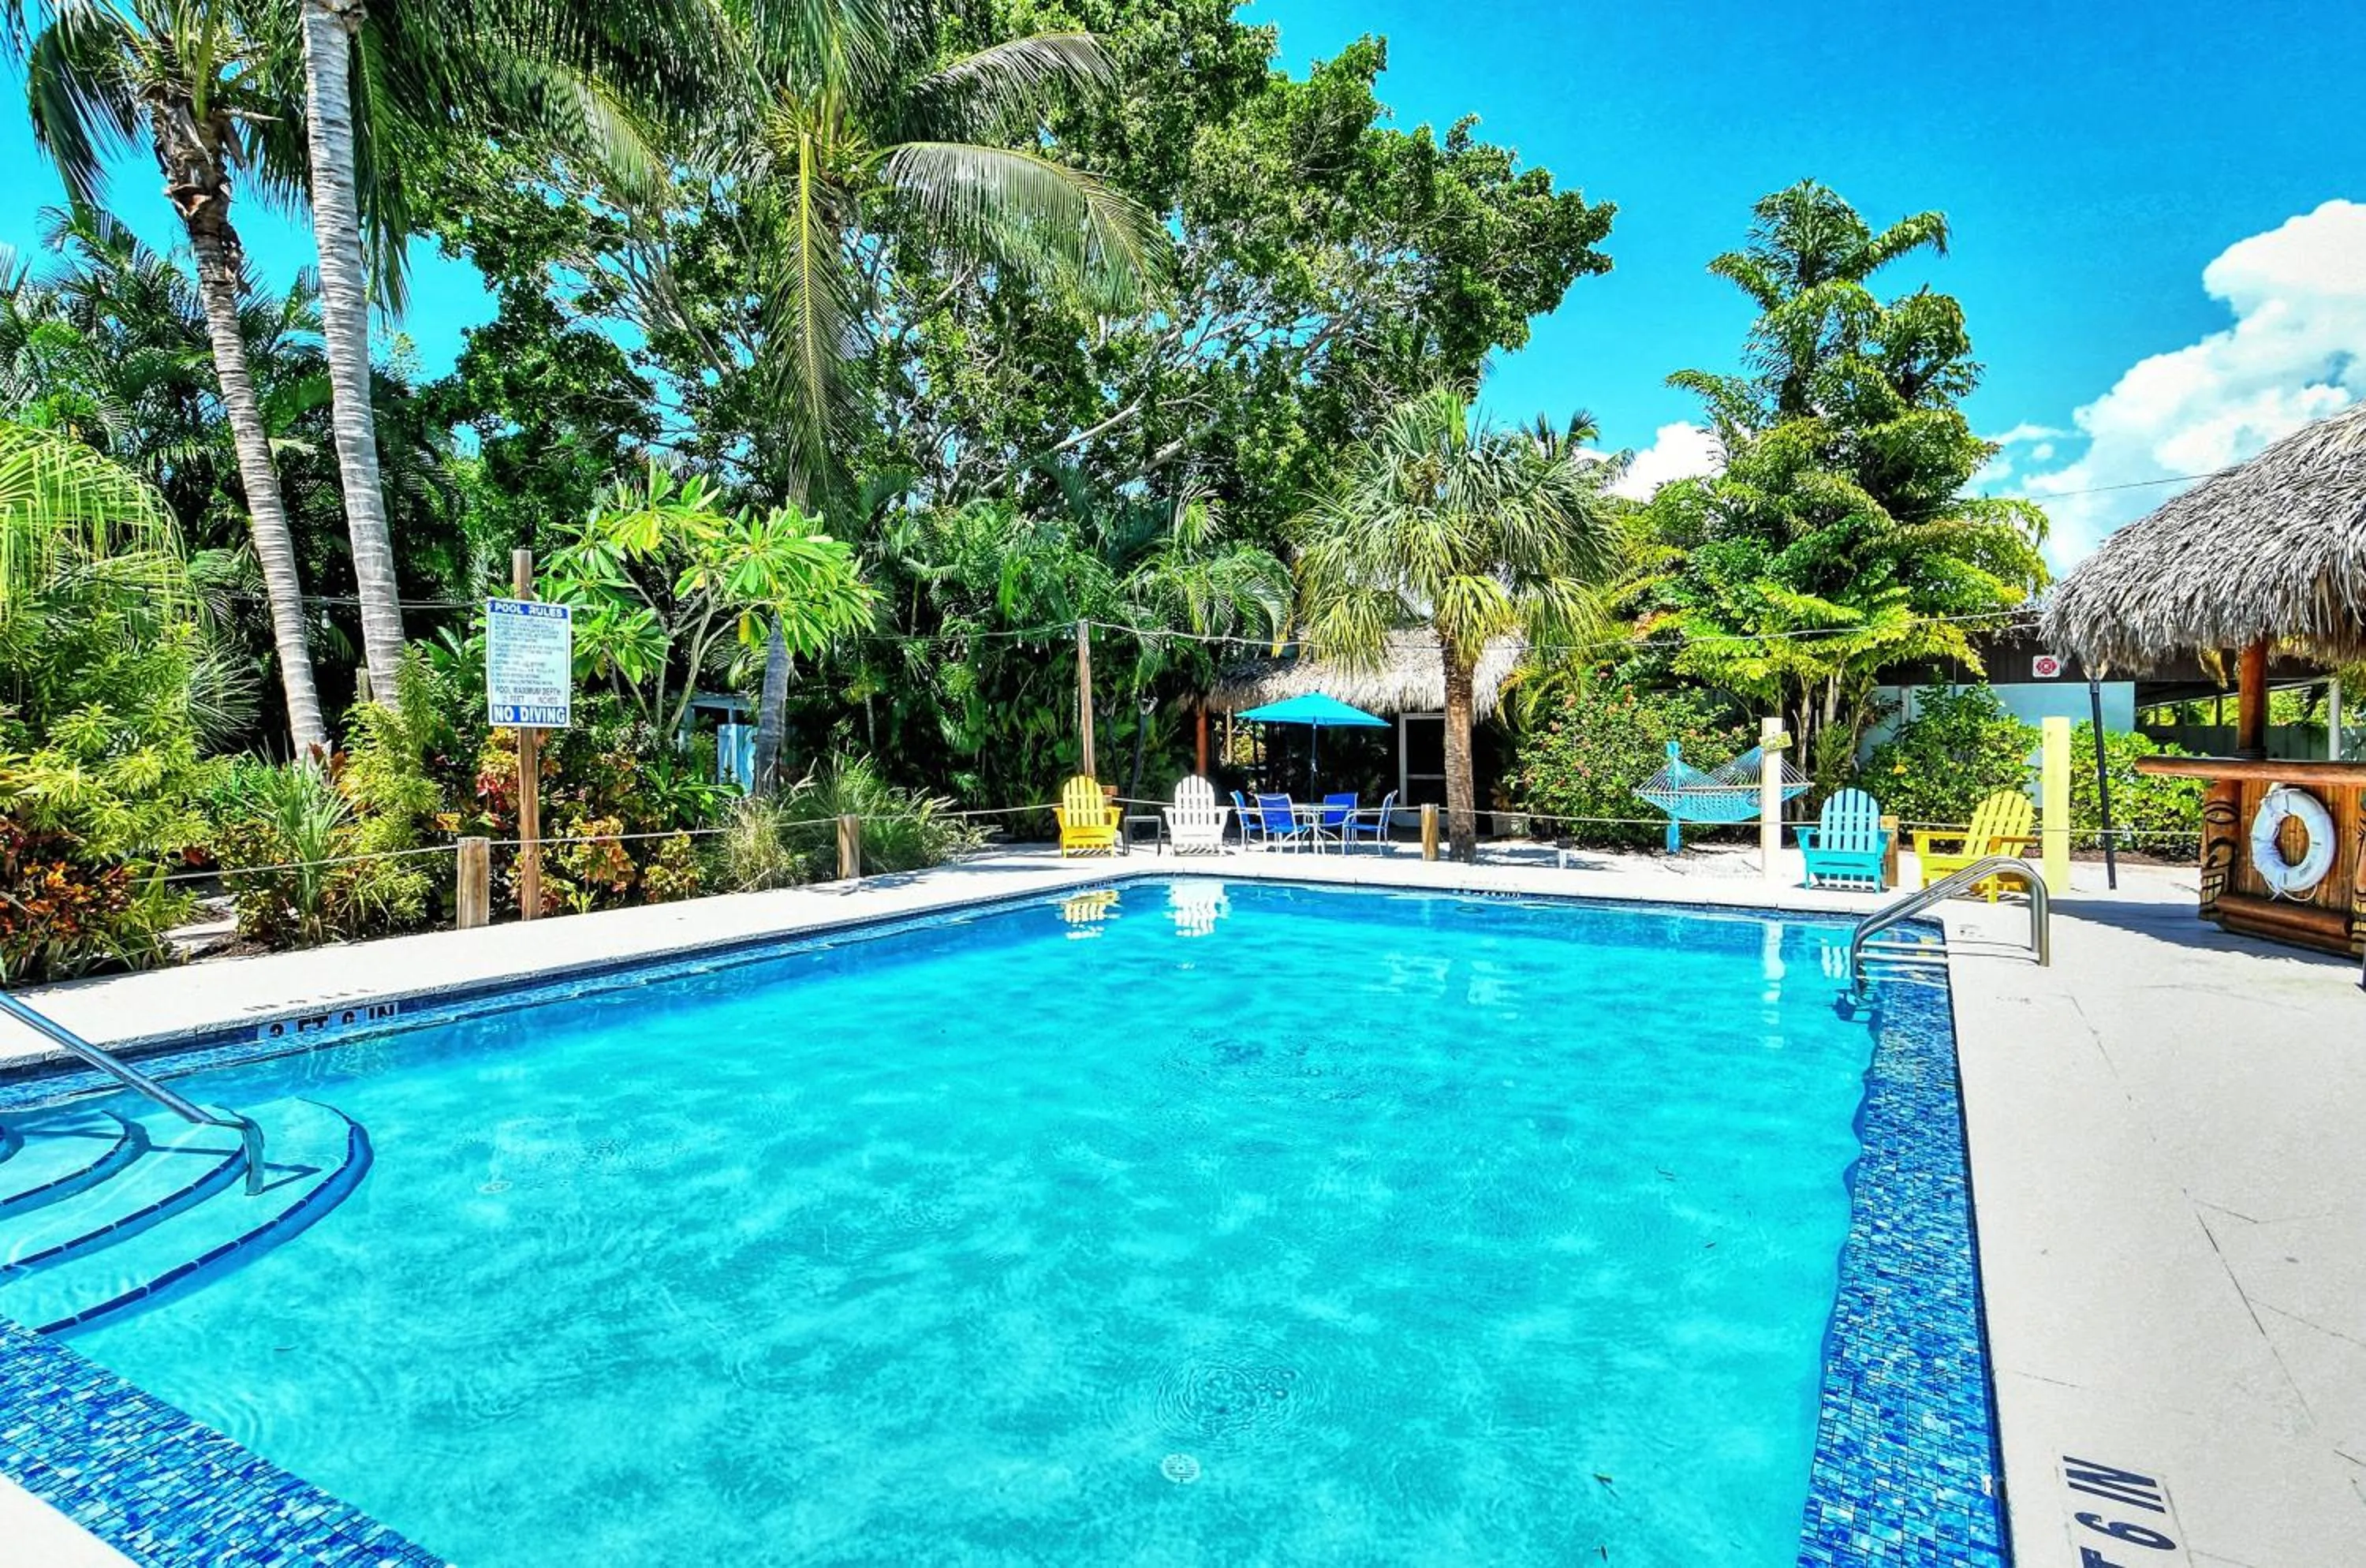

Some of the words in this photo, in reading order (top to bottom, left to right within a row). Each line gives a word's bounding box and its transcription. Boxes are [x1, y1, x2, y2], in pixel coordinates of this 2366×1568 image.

[495, 603, 524, 614] POOL
[529, 606, 562, 617] RULES
[494, 705, 514, 722] NO
[520, 706, 565, 723] DIVING
[298, 1015, 329, 1032] FT
[368, 1004, 395, 1020] IN
[2062, 1455, 2166, 1514] IN
